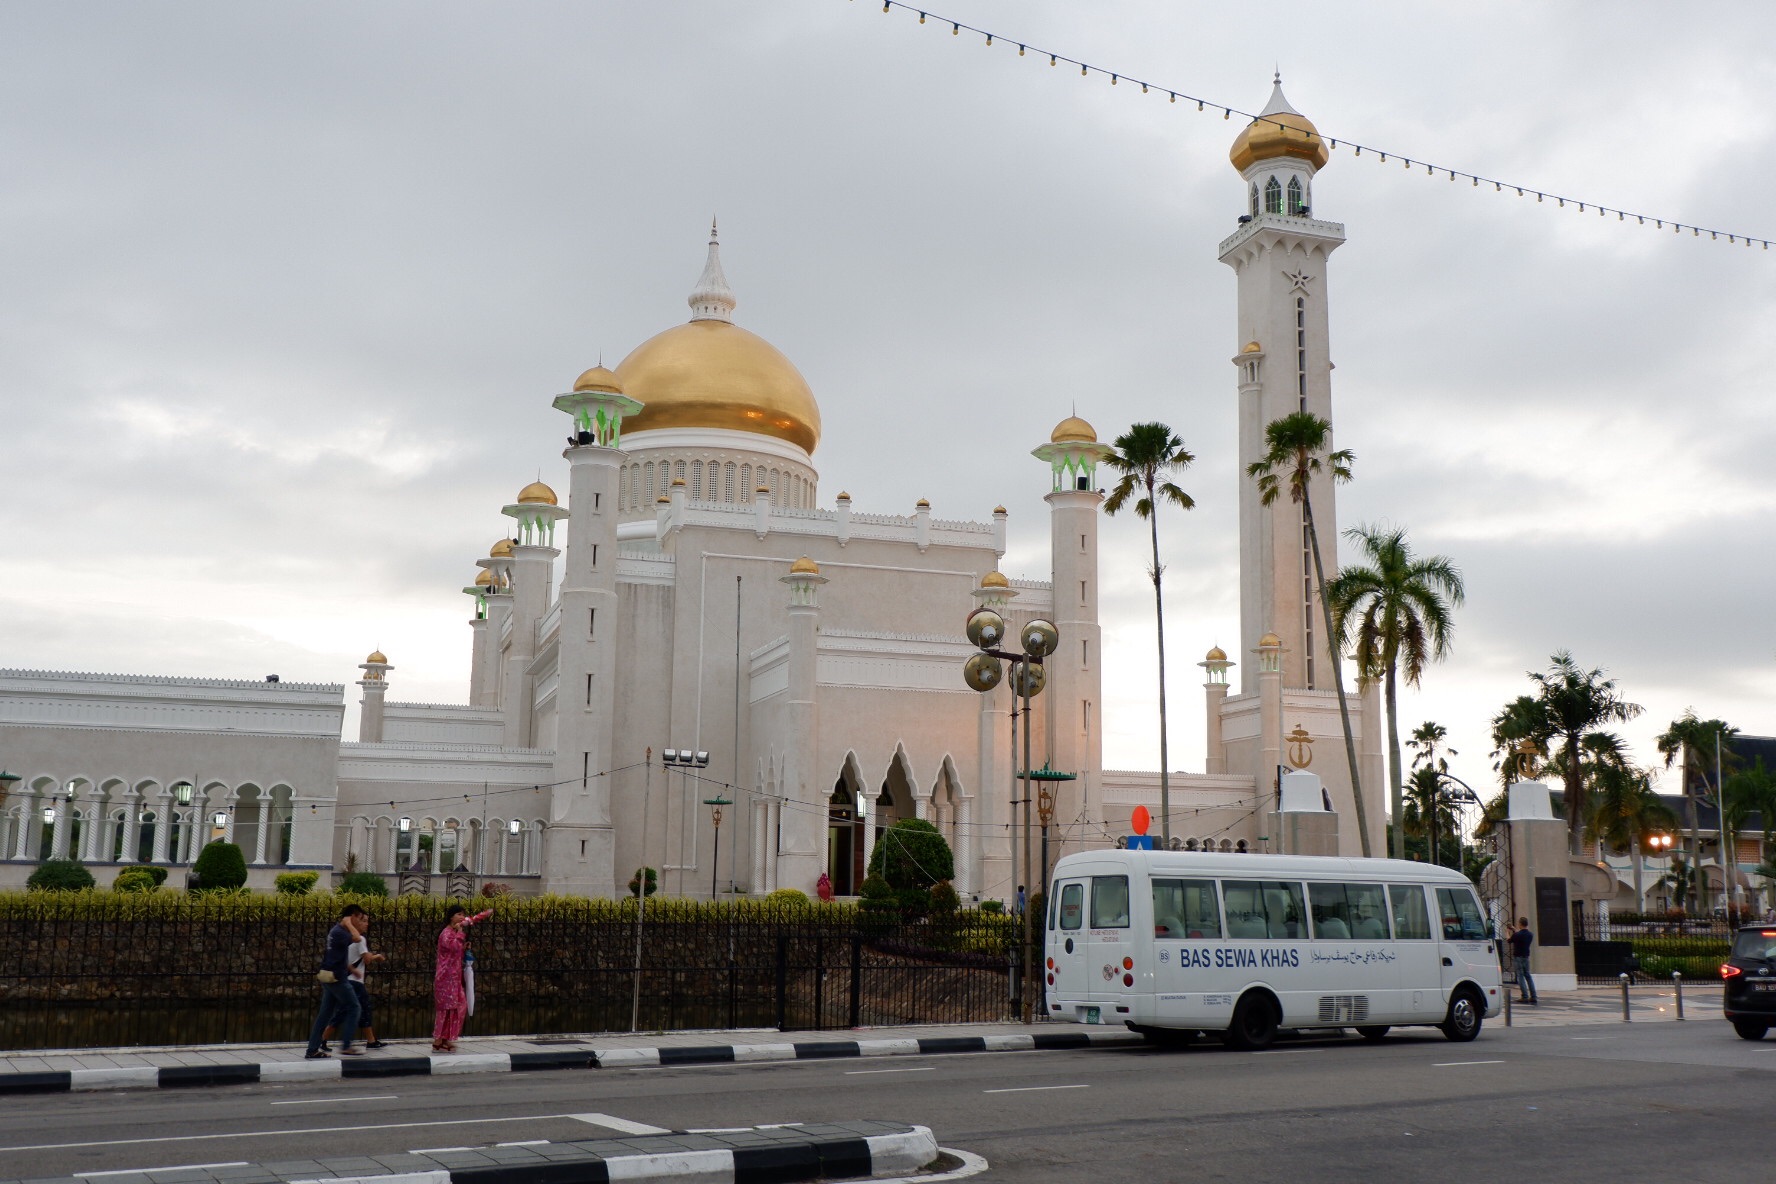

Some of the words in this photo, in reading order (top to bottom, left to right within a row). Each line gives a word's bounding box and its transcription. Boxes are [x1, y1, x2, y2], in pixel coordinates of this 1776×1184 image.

[1160, 952, 1169, 961] BS
[1180, 948, 1211, 968] BAS
[1215, 948, 1257, 968] SEWA
[1260, 948, 1299, 968] KHAS
